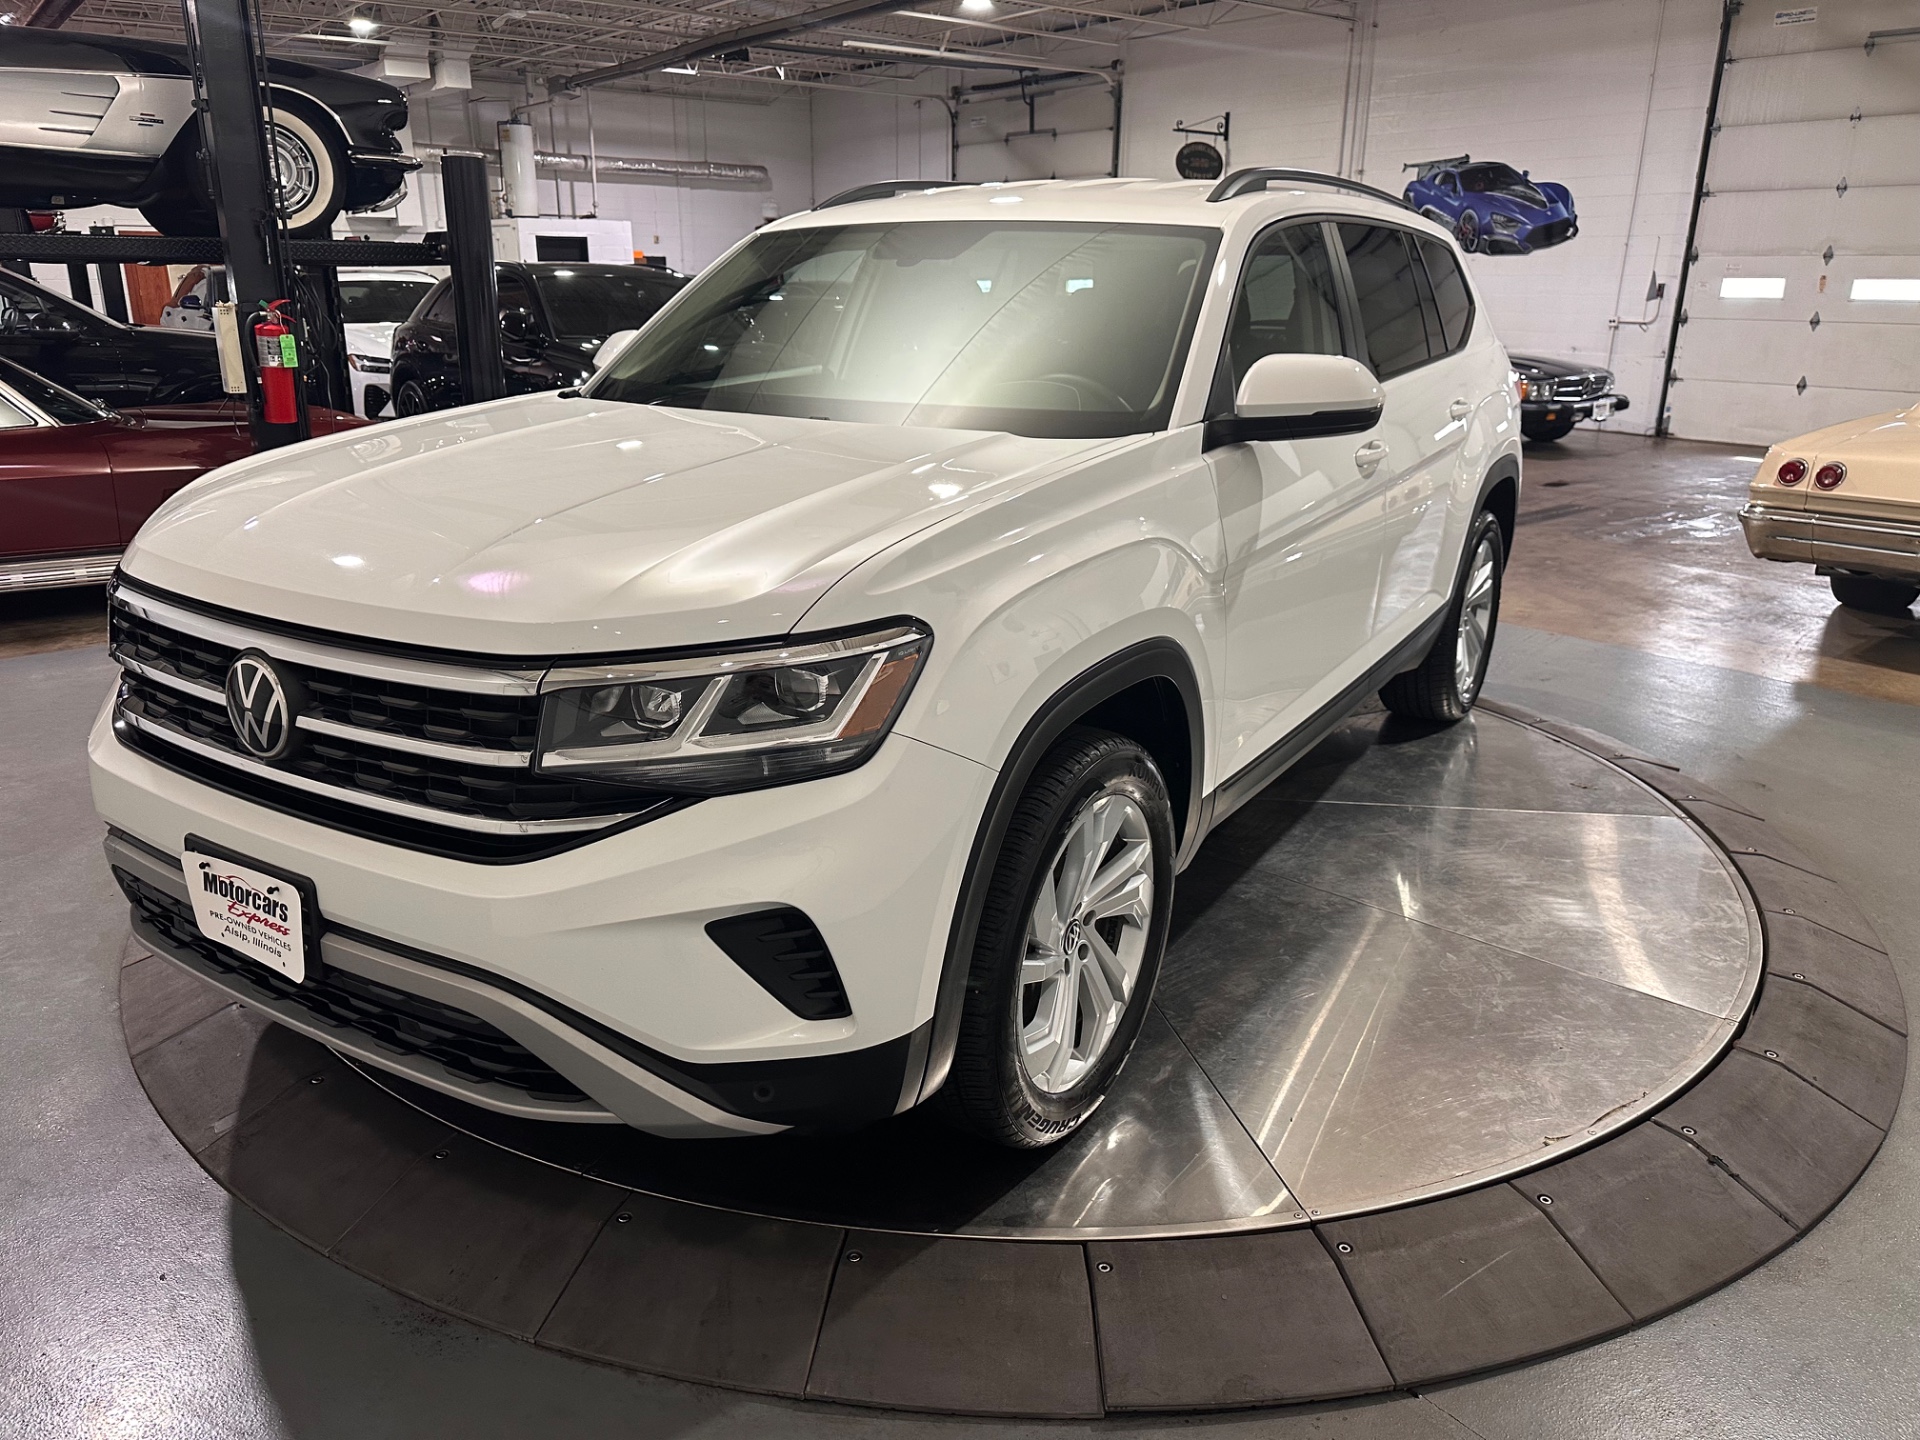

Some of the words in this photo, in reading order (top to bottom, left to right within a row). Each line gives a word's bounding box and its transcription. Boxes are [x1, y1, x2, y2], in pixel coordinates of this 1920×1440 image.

[203, 871, 288, 922] Motorcars
[209, 910, 257, 934] PRE-OWNED
[258, 929, 291, 951] VEHICLES
[227, 900, 290, 936] Express
[224, 925, 250, 943] Alsip,
[252, 936, 282, 957] Illinois
[1019, 1103, 1081, 1134] CRUGEN
